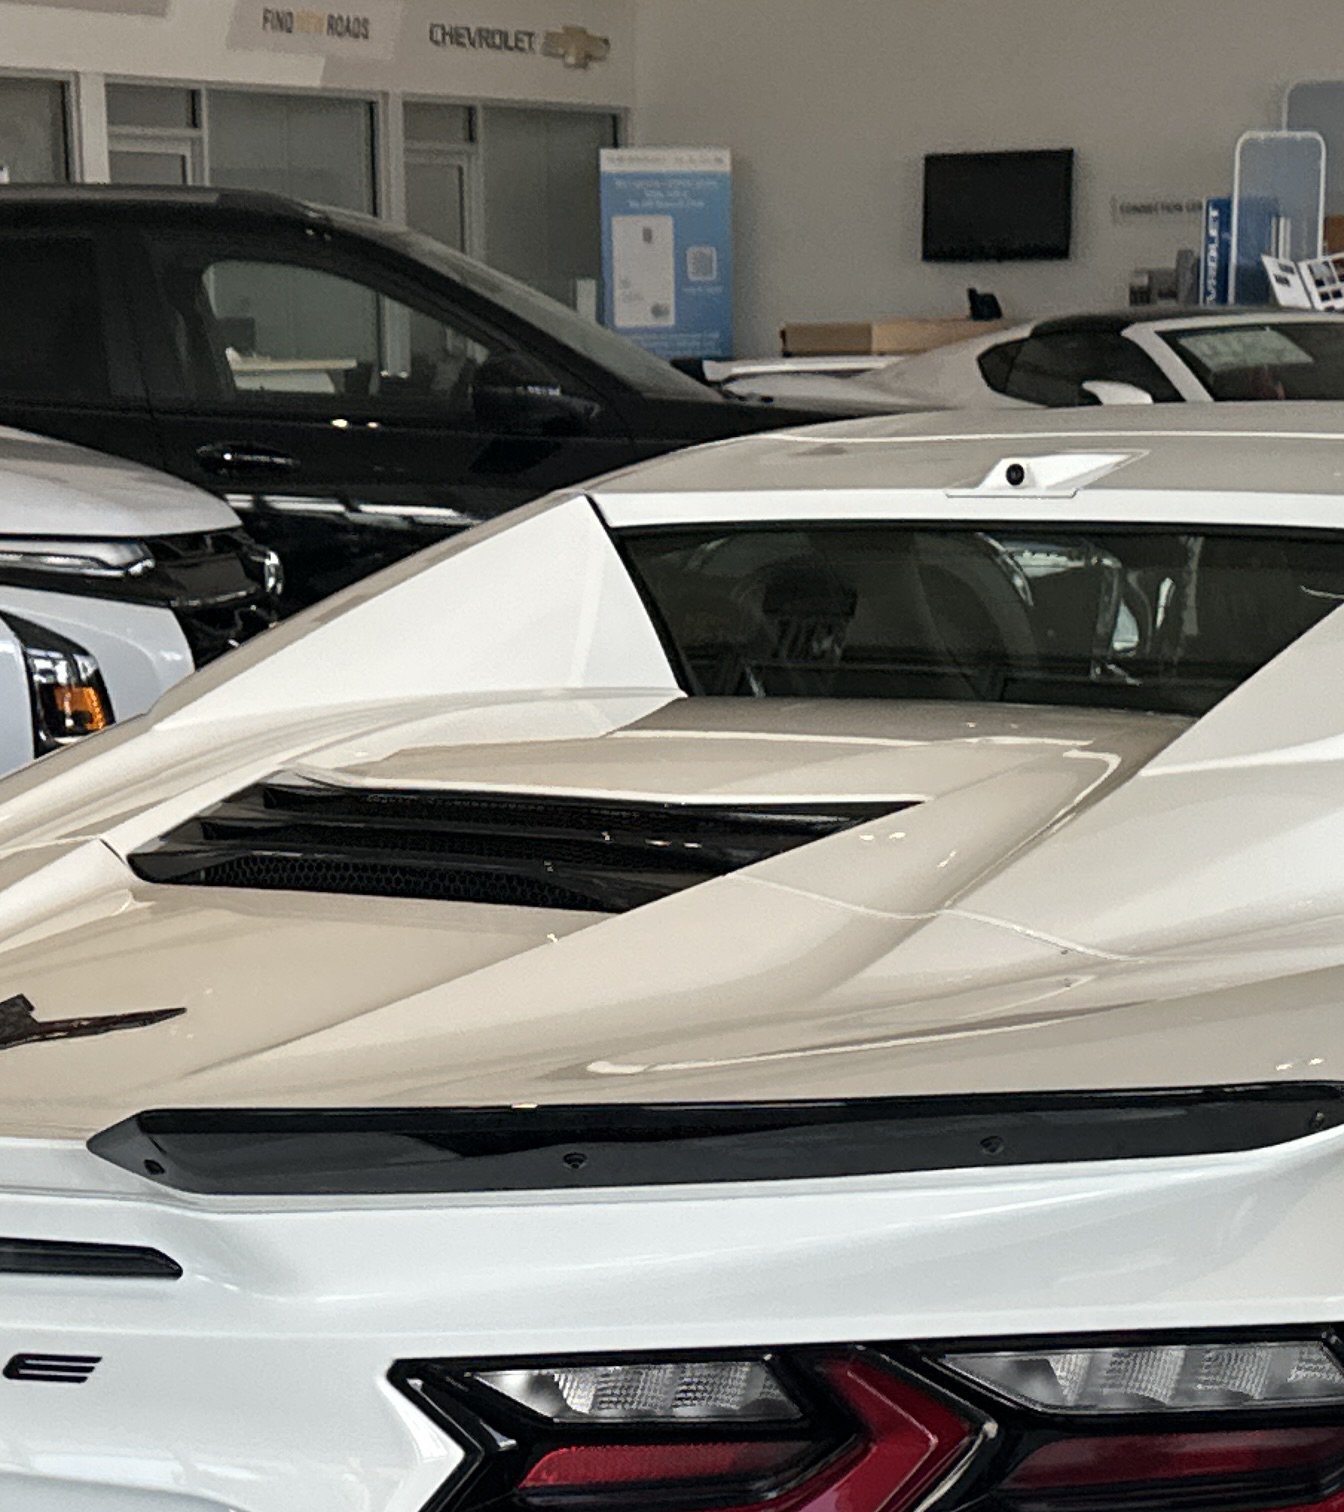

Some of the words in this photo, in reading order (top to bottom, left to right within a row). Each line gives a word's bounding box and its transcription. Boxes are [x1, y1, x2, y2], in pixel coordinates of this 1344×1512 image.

[262, 8, 294, 34] FIND
[326, 13, 370, 39] ROADS
[428, 22, 535, 53] CHEVROLET
